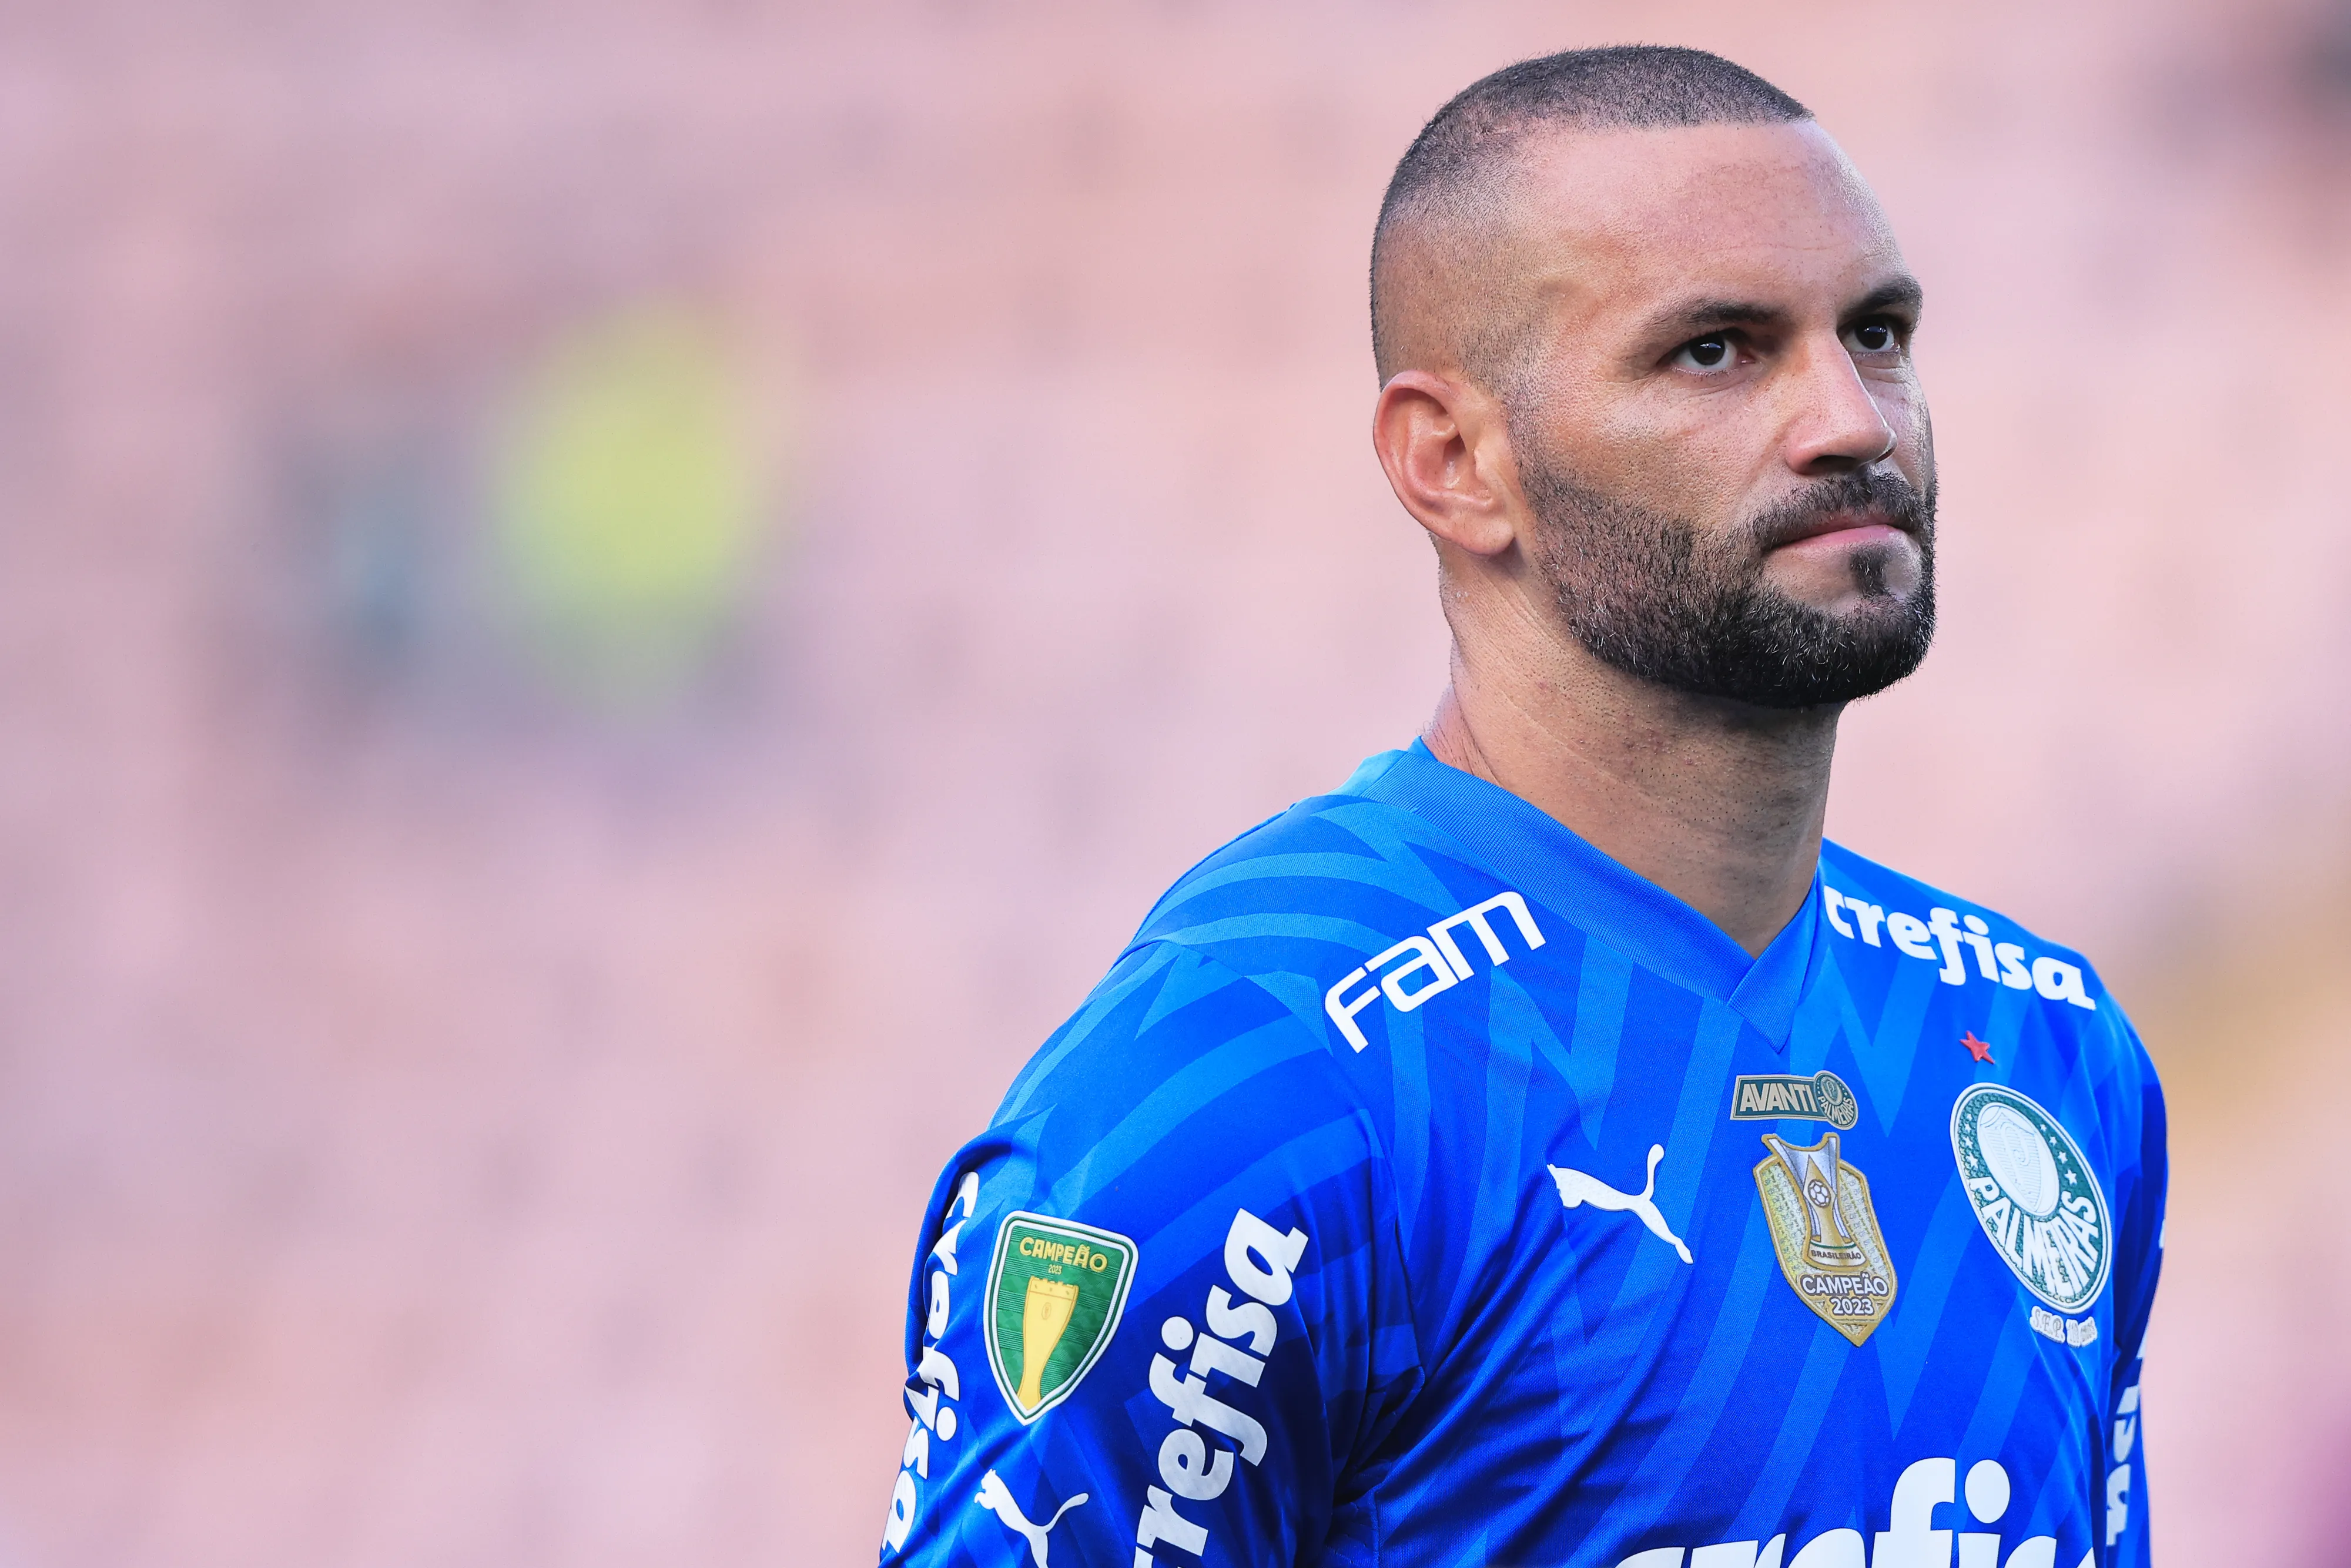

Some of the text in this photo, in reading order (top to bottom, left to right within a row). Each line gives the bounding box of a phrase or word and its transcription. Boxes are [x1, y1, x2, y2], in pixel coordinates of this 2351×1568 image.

[1823, 885, 2096, 1011] crefisa
[1739, 1083, 1817, 1112] AVANTI
[1817, 1095, 1854, 1125] PALMEIRAS
[1969, 1175, 2099, 1296] PALMEIRAS
[1019, 1236, 1107, 1272] CAMPEÃO
[1048, 1264, 1063, 1275] 2023
[1802, 1273, 1888, 1295] CAMPEÃO
[1830, 1298, 1874, 1315] 2023
